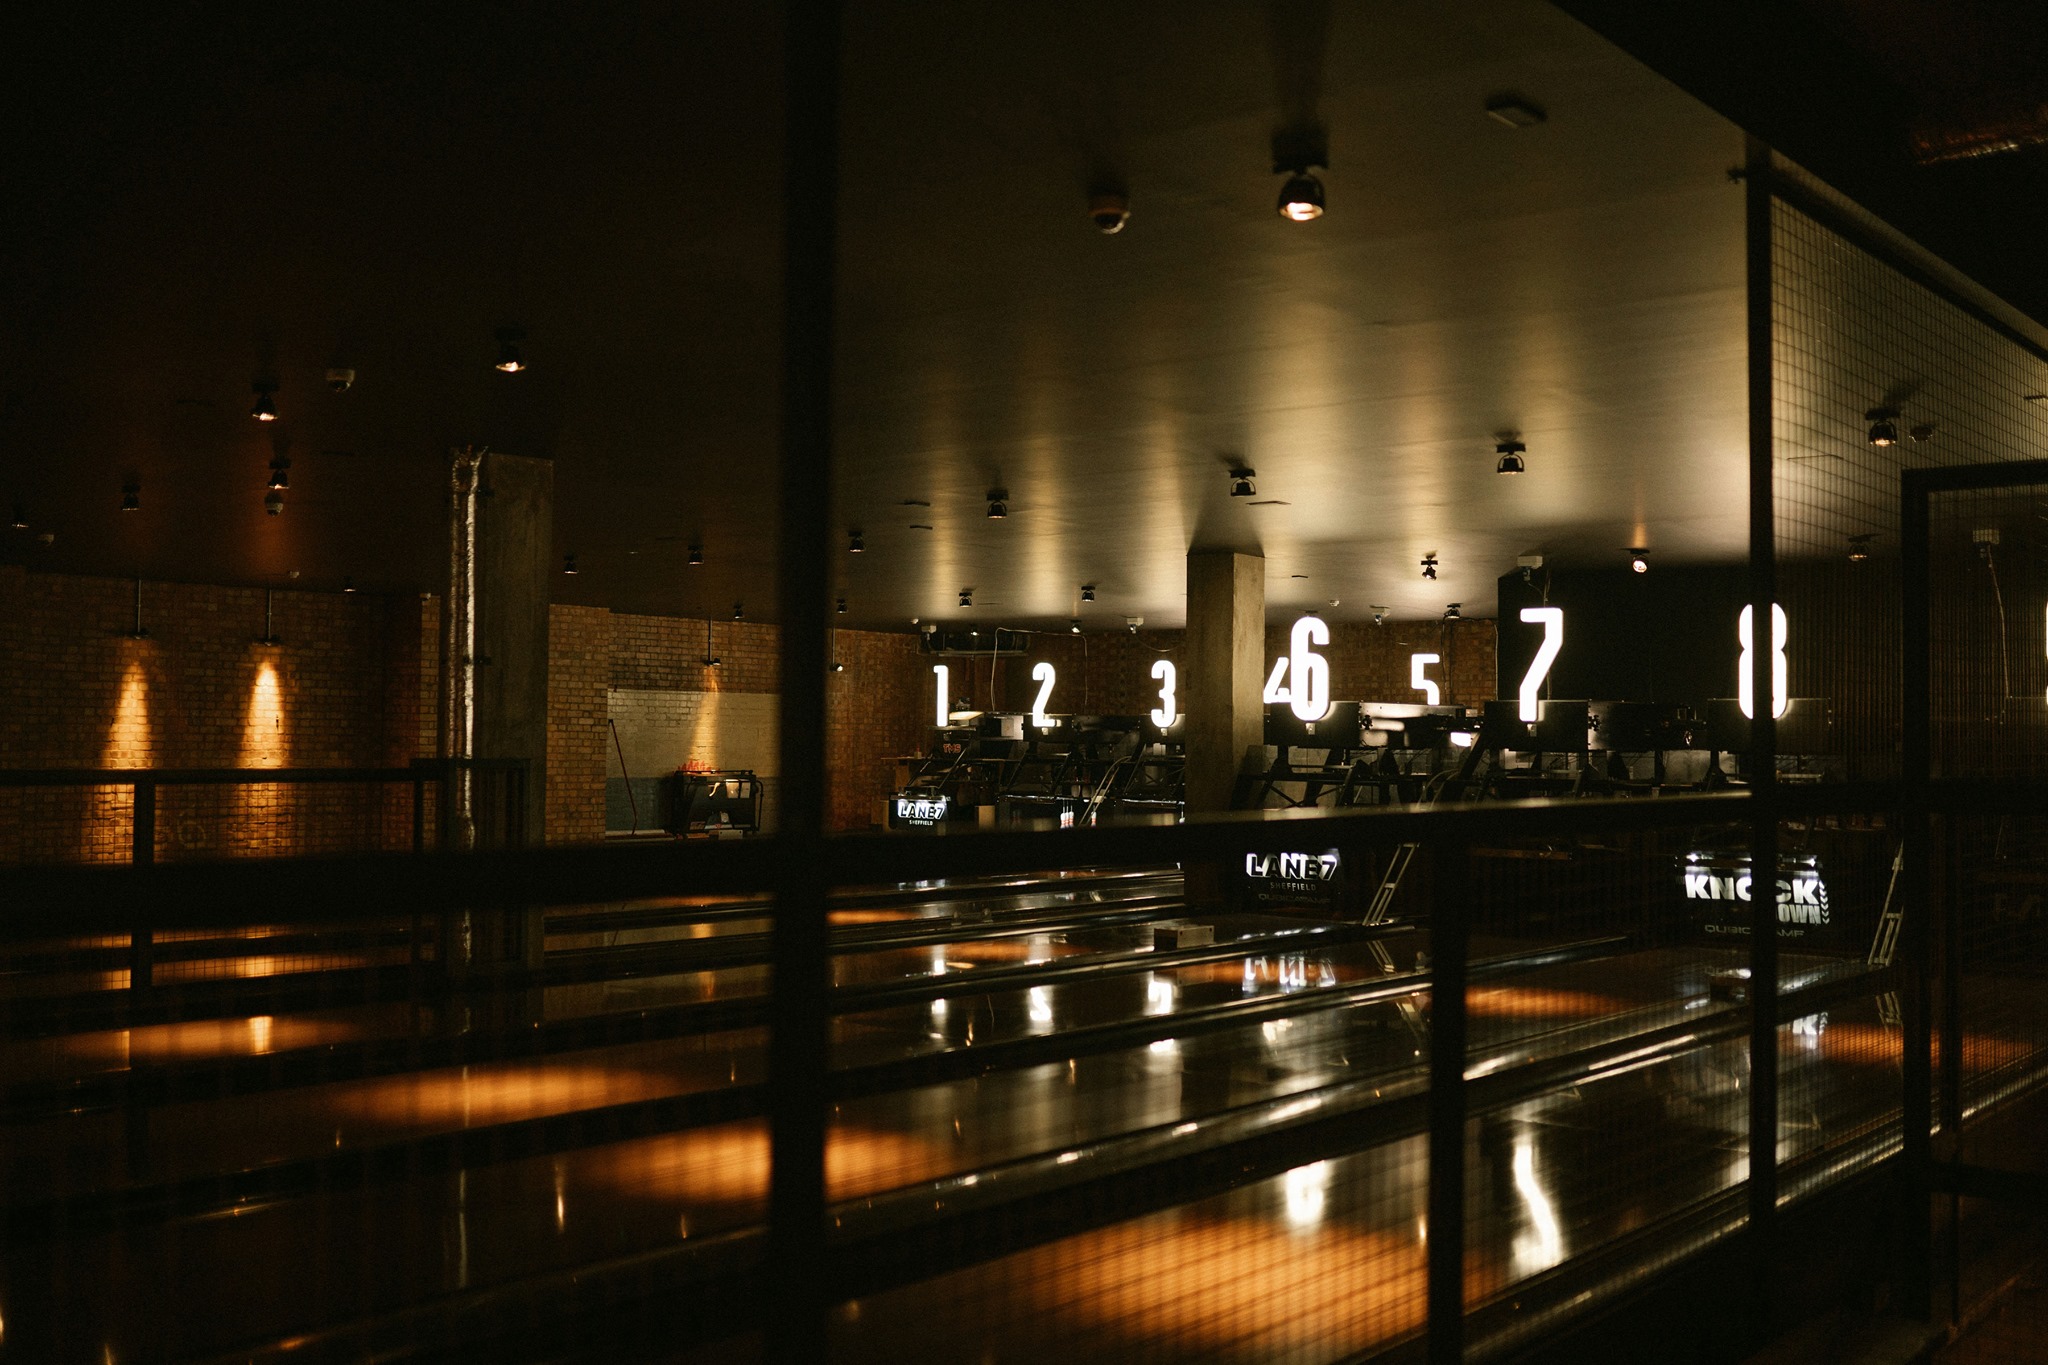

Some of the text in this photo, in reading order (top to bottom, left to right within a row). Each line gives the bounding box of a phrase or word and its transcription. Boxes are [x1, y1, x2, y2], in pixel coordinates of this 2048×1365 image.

[1264, 657, 1292, 704] 4
[1290, 616, 1331, 721] 6
[1411, 654, 1441, 706] 5
[1519, 607, 1564, 722] 7
[933, 665, 949, 728] 1
[1032, 663, 1057, 728] 2
[1150, 660, 1177, 728] 3
[897, 799, 946, 819] LANE7
[1245, 852, 1338, 881] LANE7
[1269, 881, 1317, 892] SHEFFIELD
[1775, 903, 1822, 925] OWN
